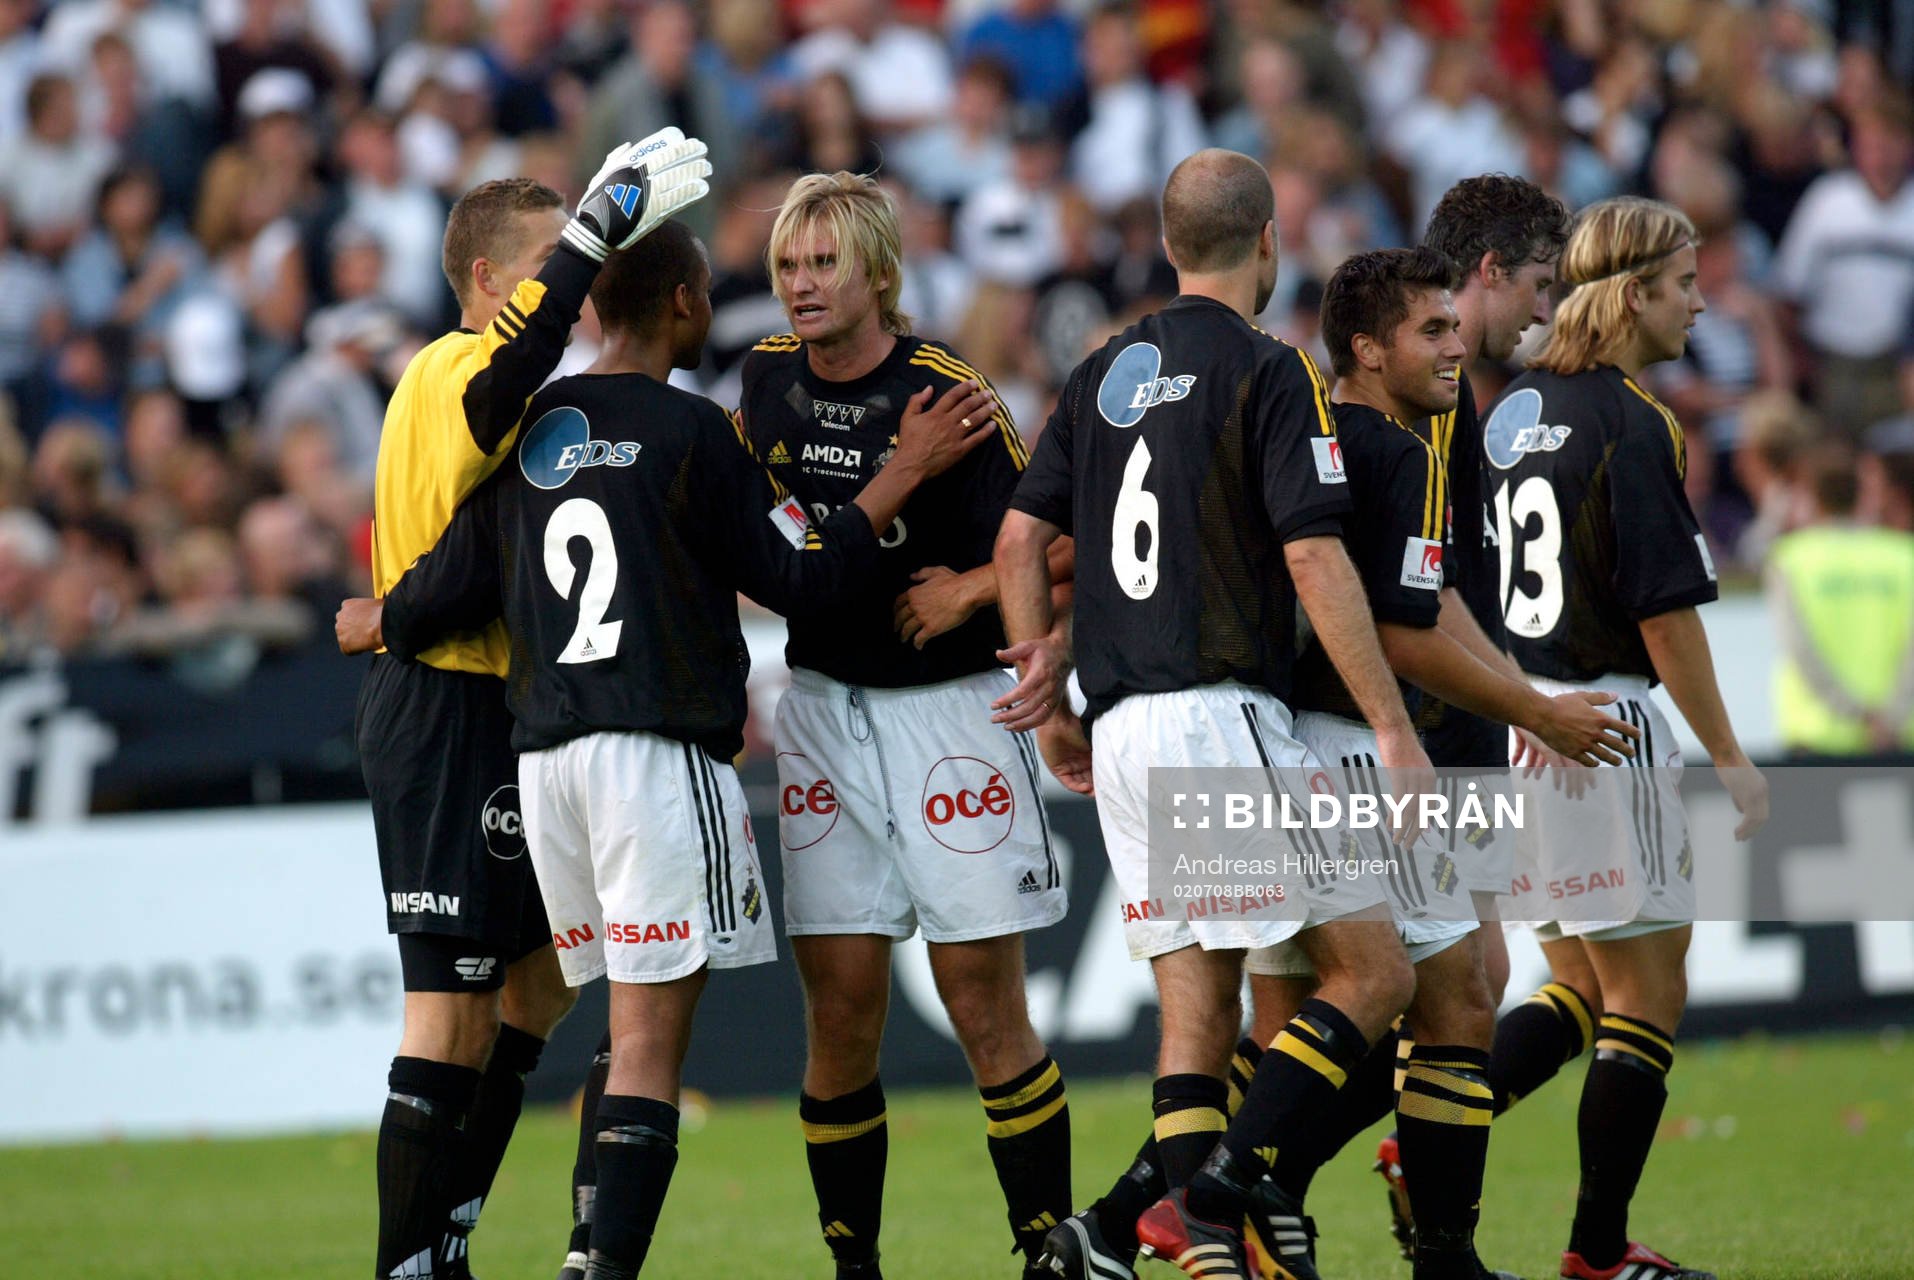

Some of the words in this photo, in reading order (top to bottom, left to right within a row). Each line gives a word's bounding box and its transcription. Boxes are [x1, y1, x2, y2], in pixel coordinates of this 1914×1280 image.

[630, 139, 667, 162] adidas
[1128, 374, 1197, 409] EDS
[815, 402, 863, 419] COLT
[821, 420, 850, 431] Telecom
[801, 443, 844, 465] AMD
[1510, 424, 1572, 453] EDS
[555, 440, 642, 471] EDS
[1112, 435, 1159, 600] 6
[1494, 476, 1563, 638] 13
[543, 498, 623, 664] 2
[780, 779, 837, 817] cé
[925, 774, 1011, 826] océ
[485, 806, 526, 838] oc
[1546, 868, 1625, 900] SSAN
[1186, 883, 1286, 922] NISAN
